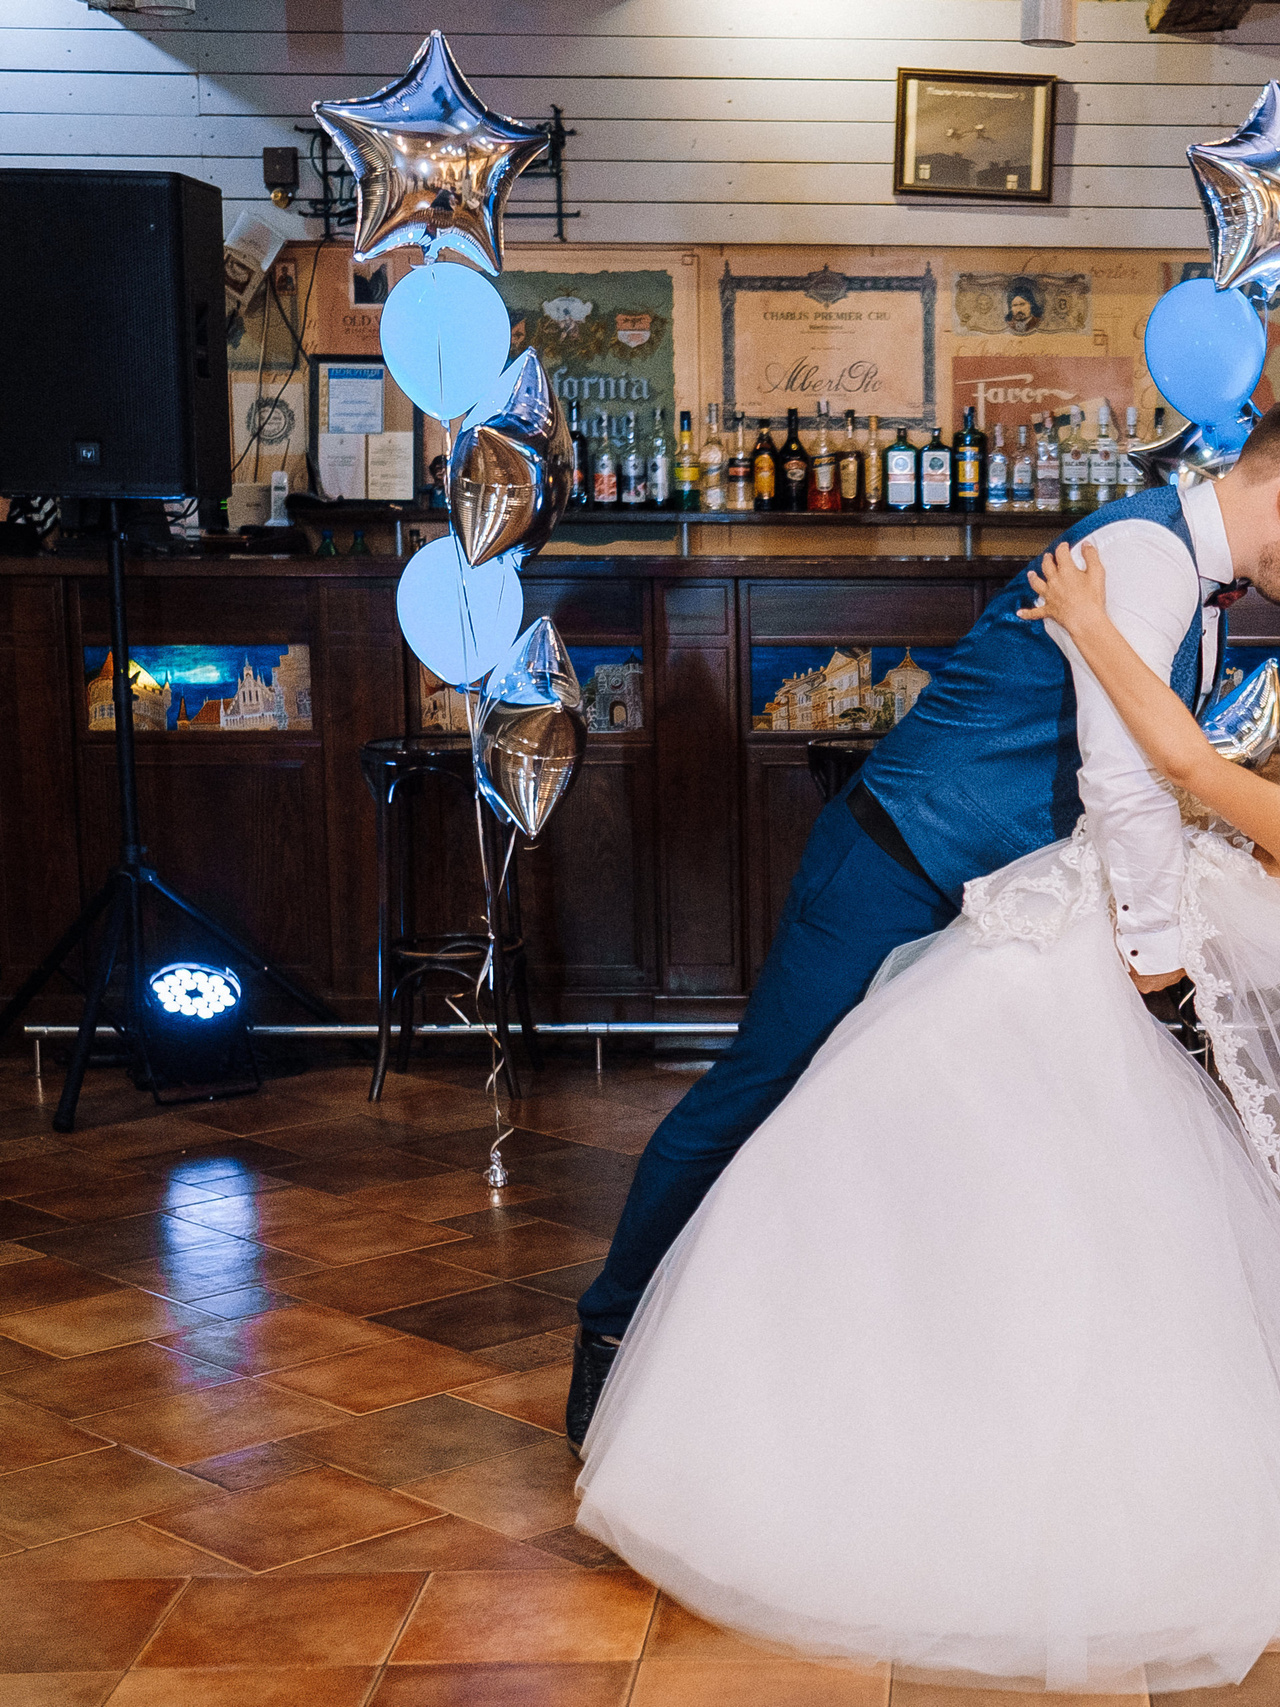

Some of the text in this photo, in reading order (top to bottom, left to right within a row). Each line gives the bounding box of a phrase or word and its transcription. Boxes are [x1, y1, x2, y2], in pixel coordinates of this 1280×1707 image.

[763, 311, 890, 321] CHABLIS PREMIER CRU
[552, 366, 650, 400] fornia
[757, 355, 846, 393] Albert
